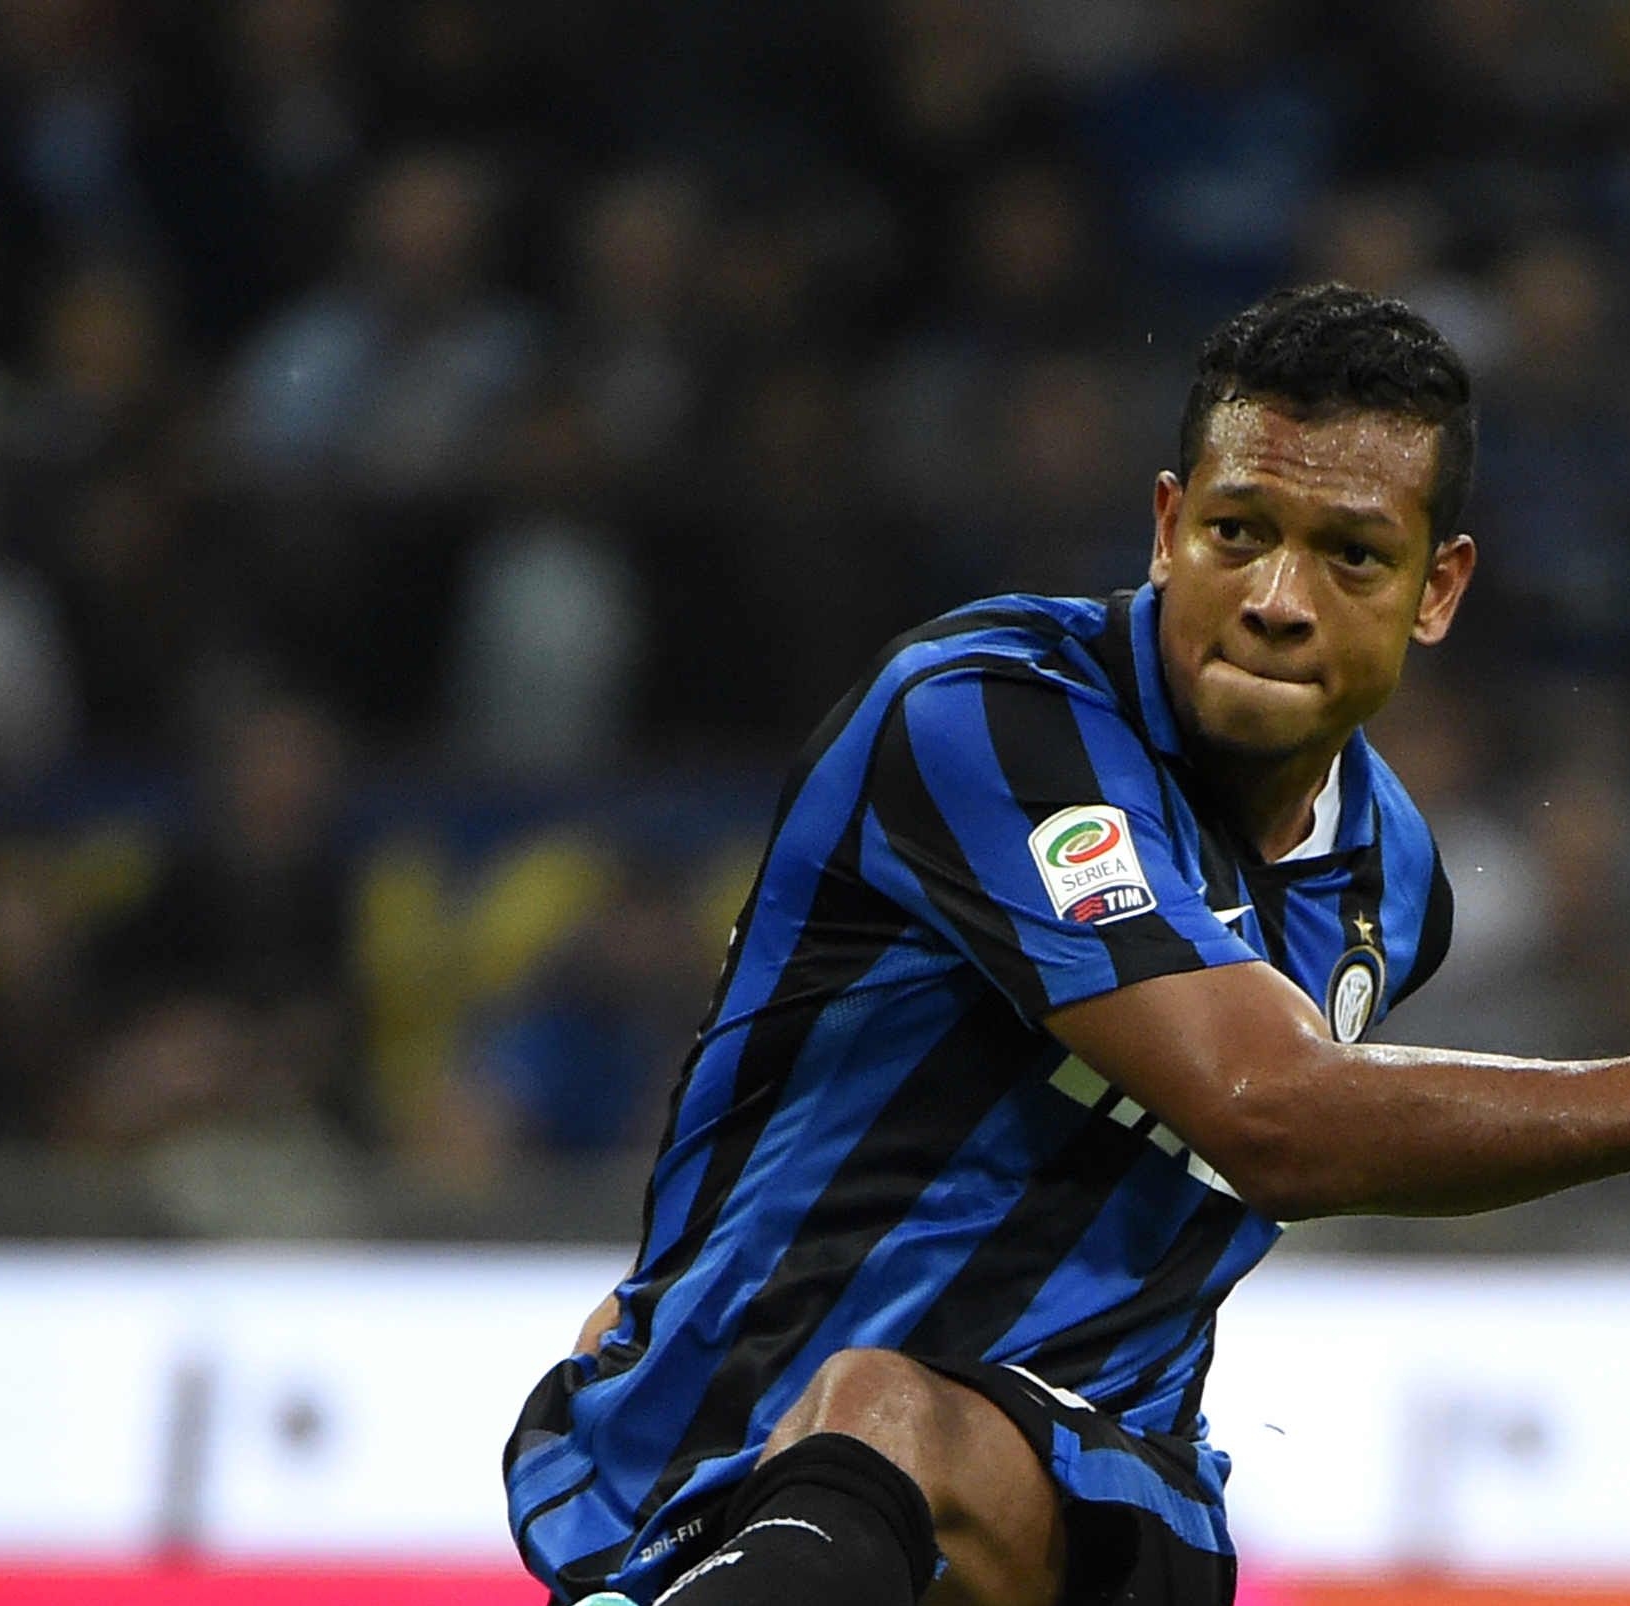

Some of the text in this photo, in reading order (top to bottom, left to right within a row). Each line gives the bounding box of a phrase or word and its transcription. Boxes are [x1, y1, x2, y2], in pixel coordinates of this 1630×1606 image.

[1061, 857, 1128, 892] SERIE A
[1102, 888, 1143, 912] TIM
[640, 1518, 702, 1563] DRI-FIT
